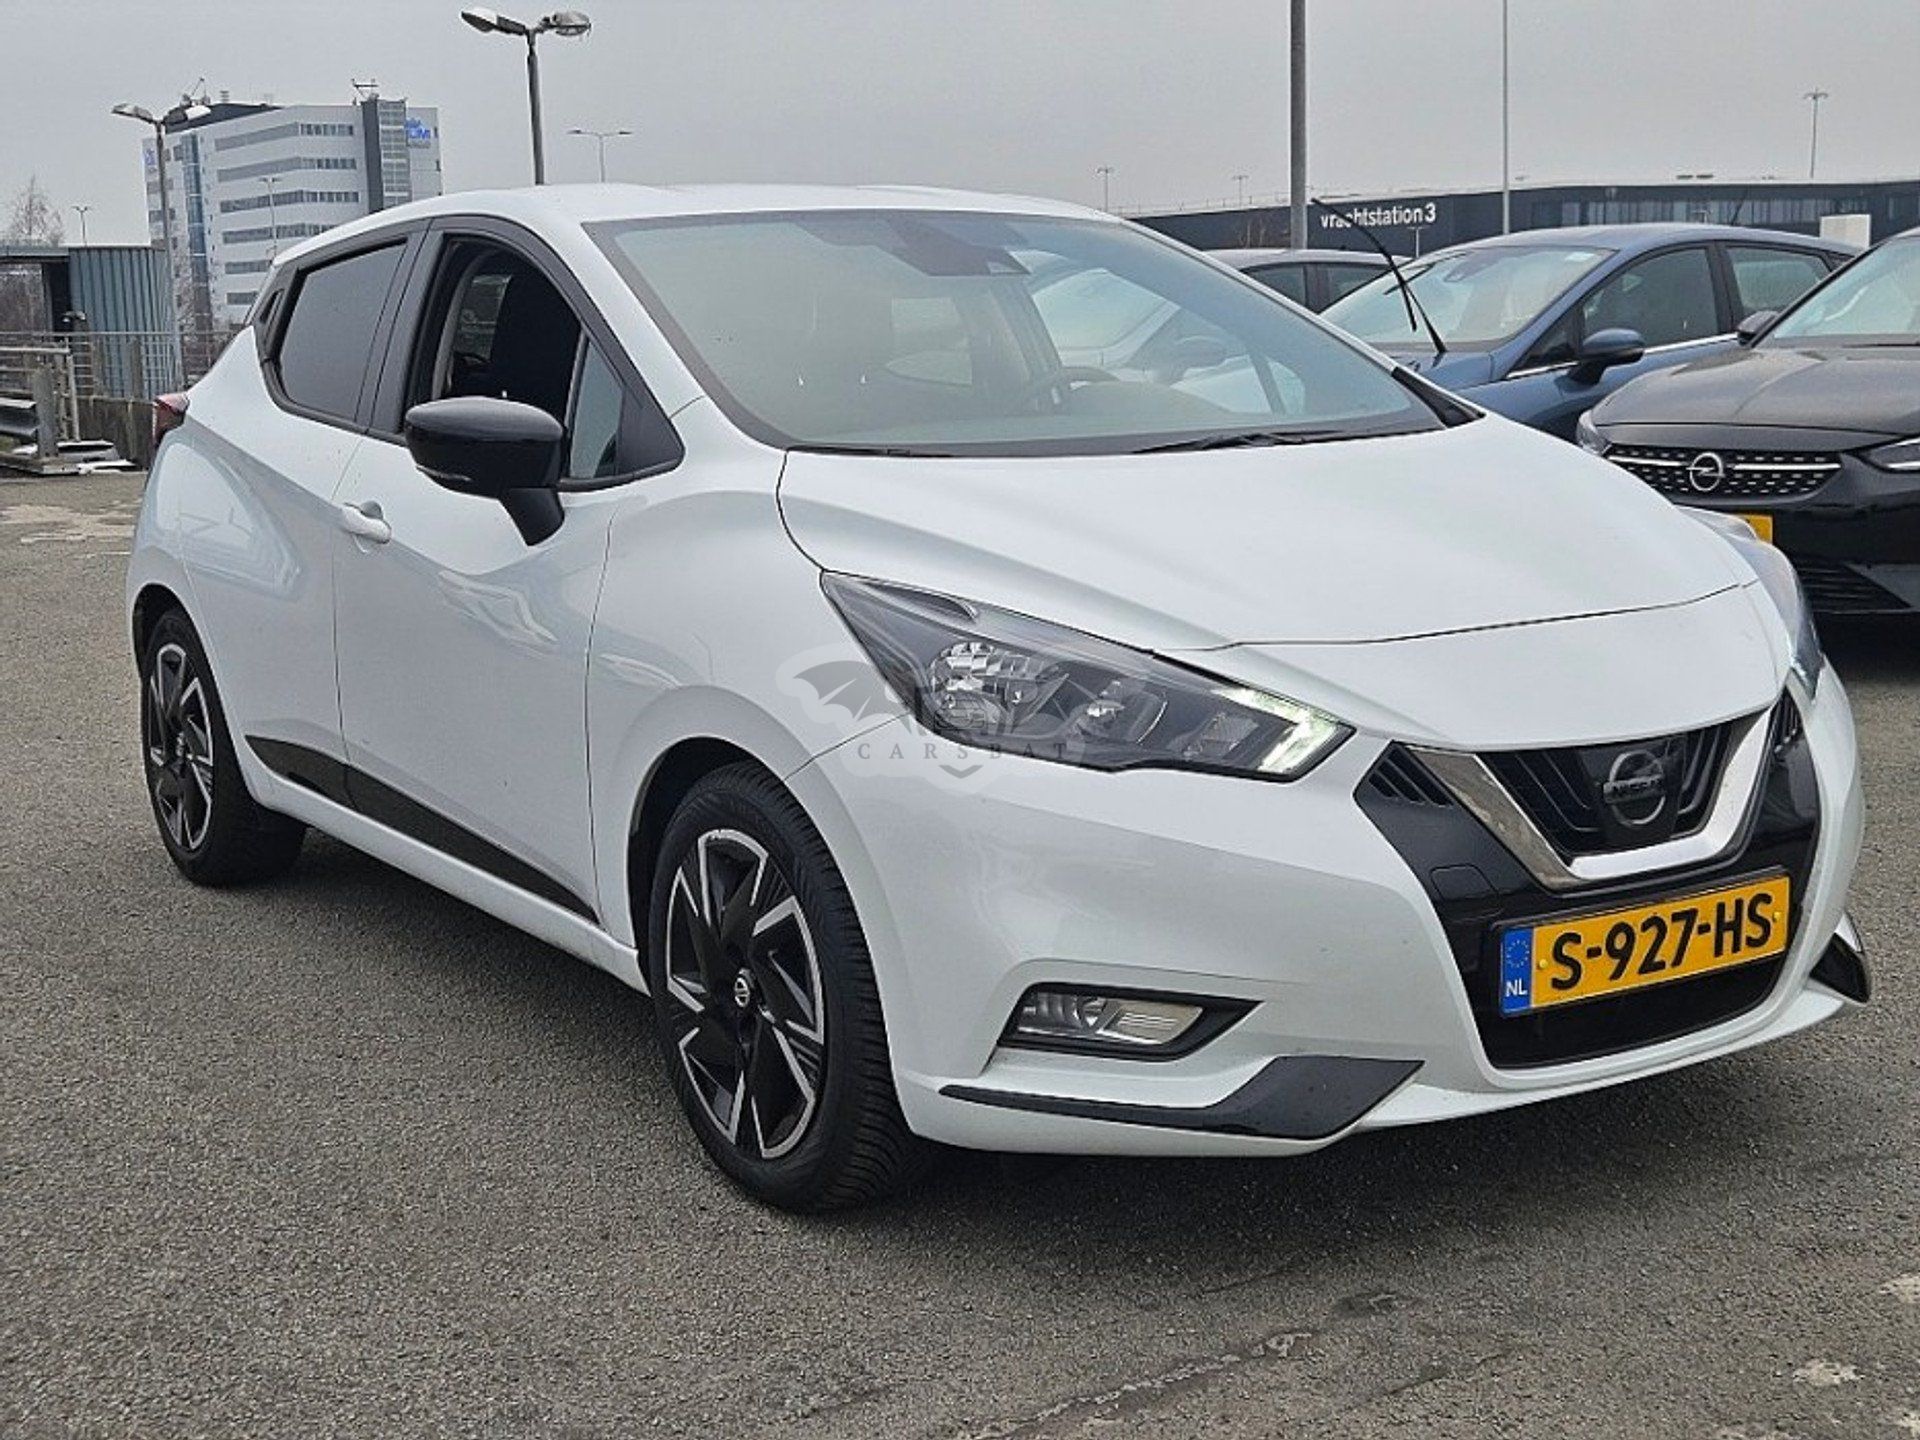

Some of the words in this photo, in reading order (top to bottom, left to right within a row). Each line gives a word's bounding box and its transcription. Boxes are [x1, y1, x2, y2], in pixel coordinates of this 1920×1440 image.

[1425, 202, 1436, 223] 3
[1551, 893, 1773, 990] S-927-HS
[1505, 980, 1528, 997] NL
